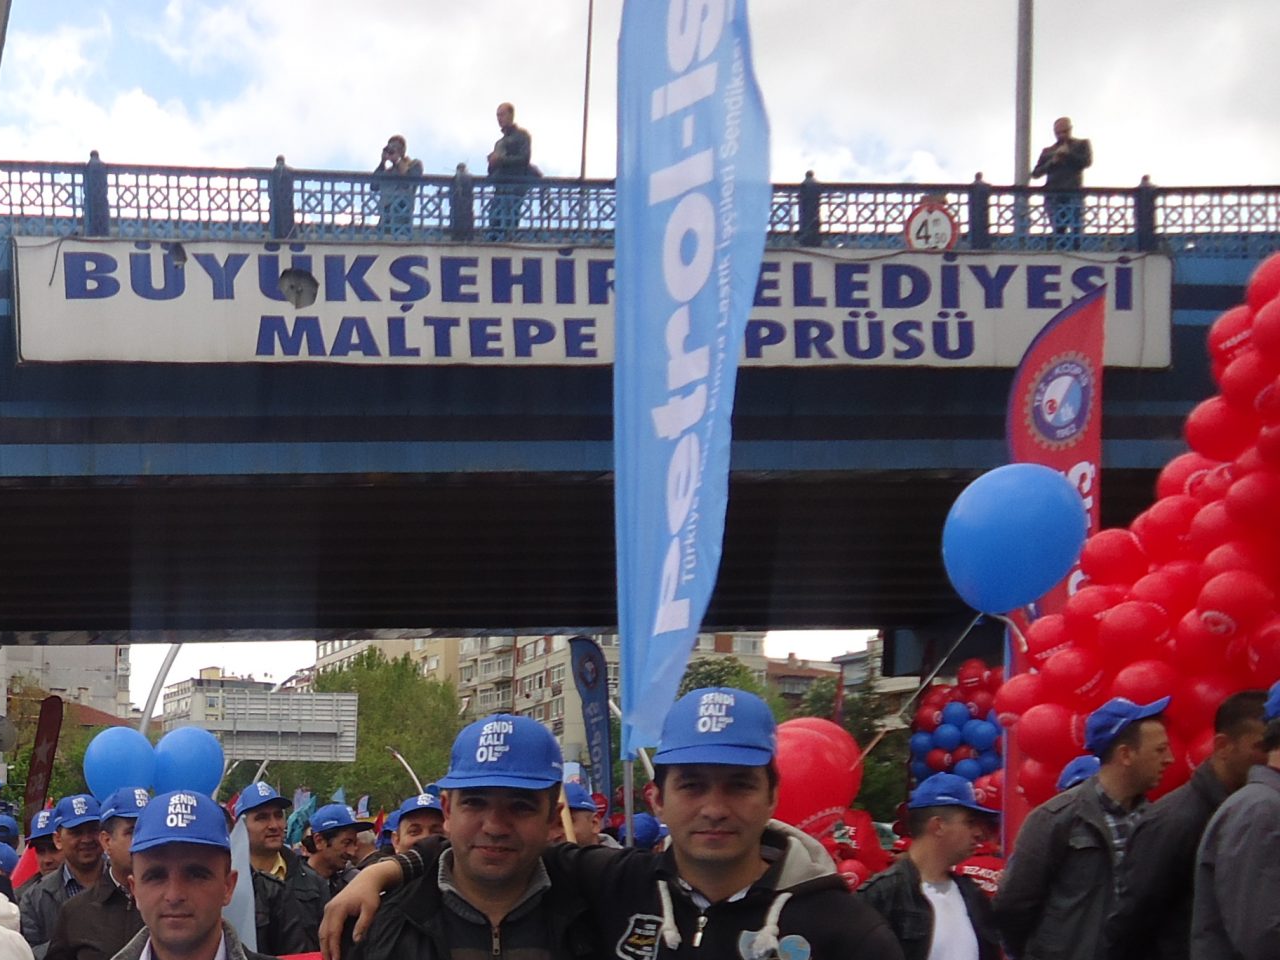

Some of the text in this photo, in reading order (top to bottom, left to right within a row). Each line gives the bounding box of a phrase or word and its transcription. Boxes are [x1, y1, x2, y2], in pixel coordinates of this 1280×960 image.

[754, 250, 1133, 312] ELEDİYESİ
[255, 309, 976, 360] MALTEPE PRÜSÜ
[698, 717, 721, 732] OL
[479, 733, 504, 746] KALI
[476, 746, 498, 763] OL
[167, 804, 191, 814] KALI
[166, 814, 187, 828] OL
